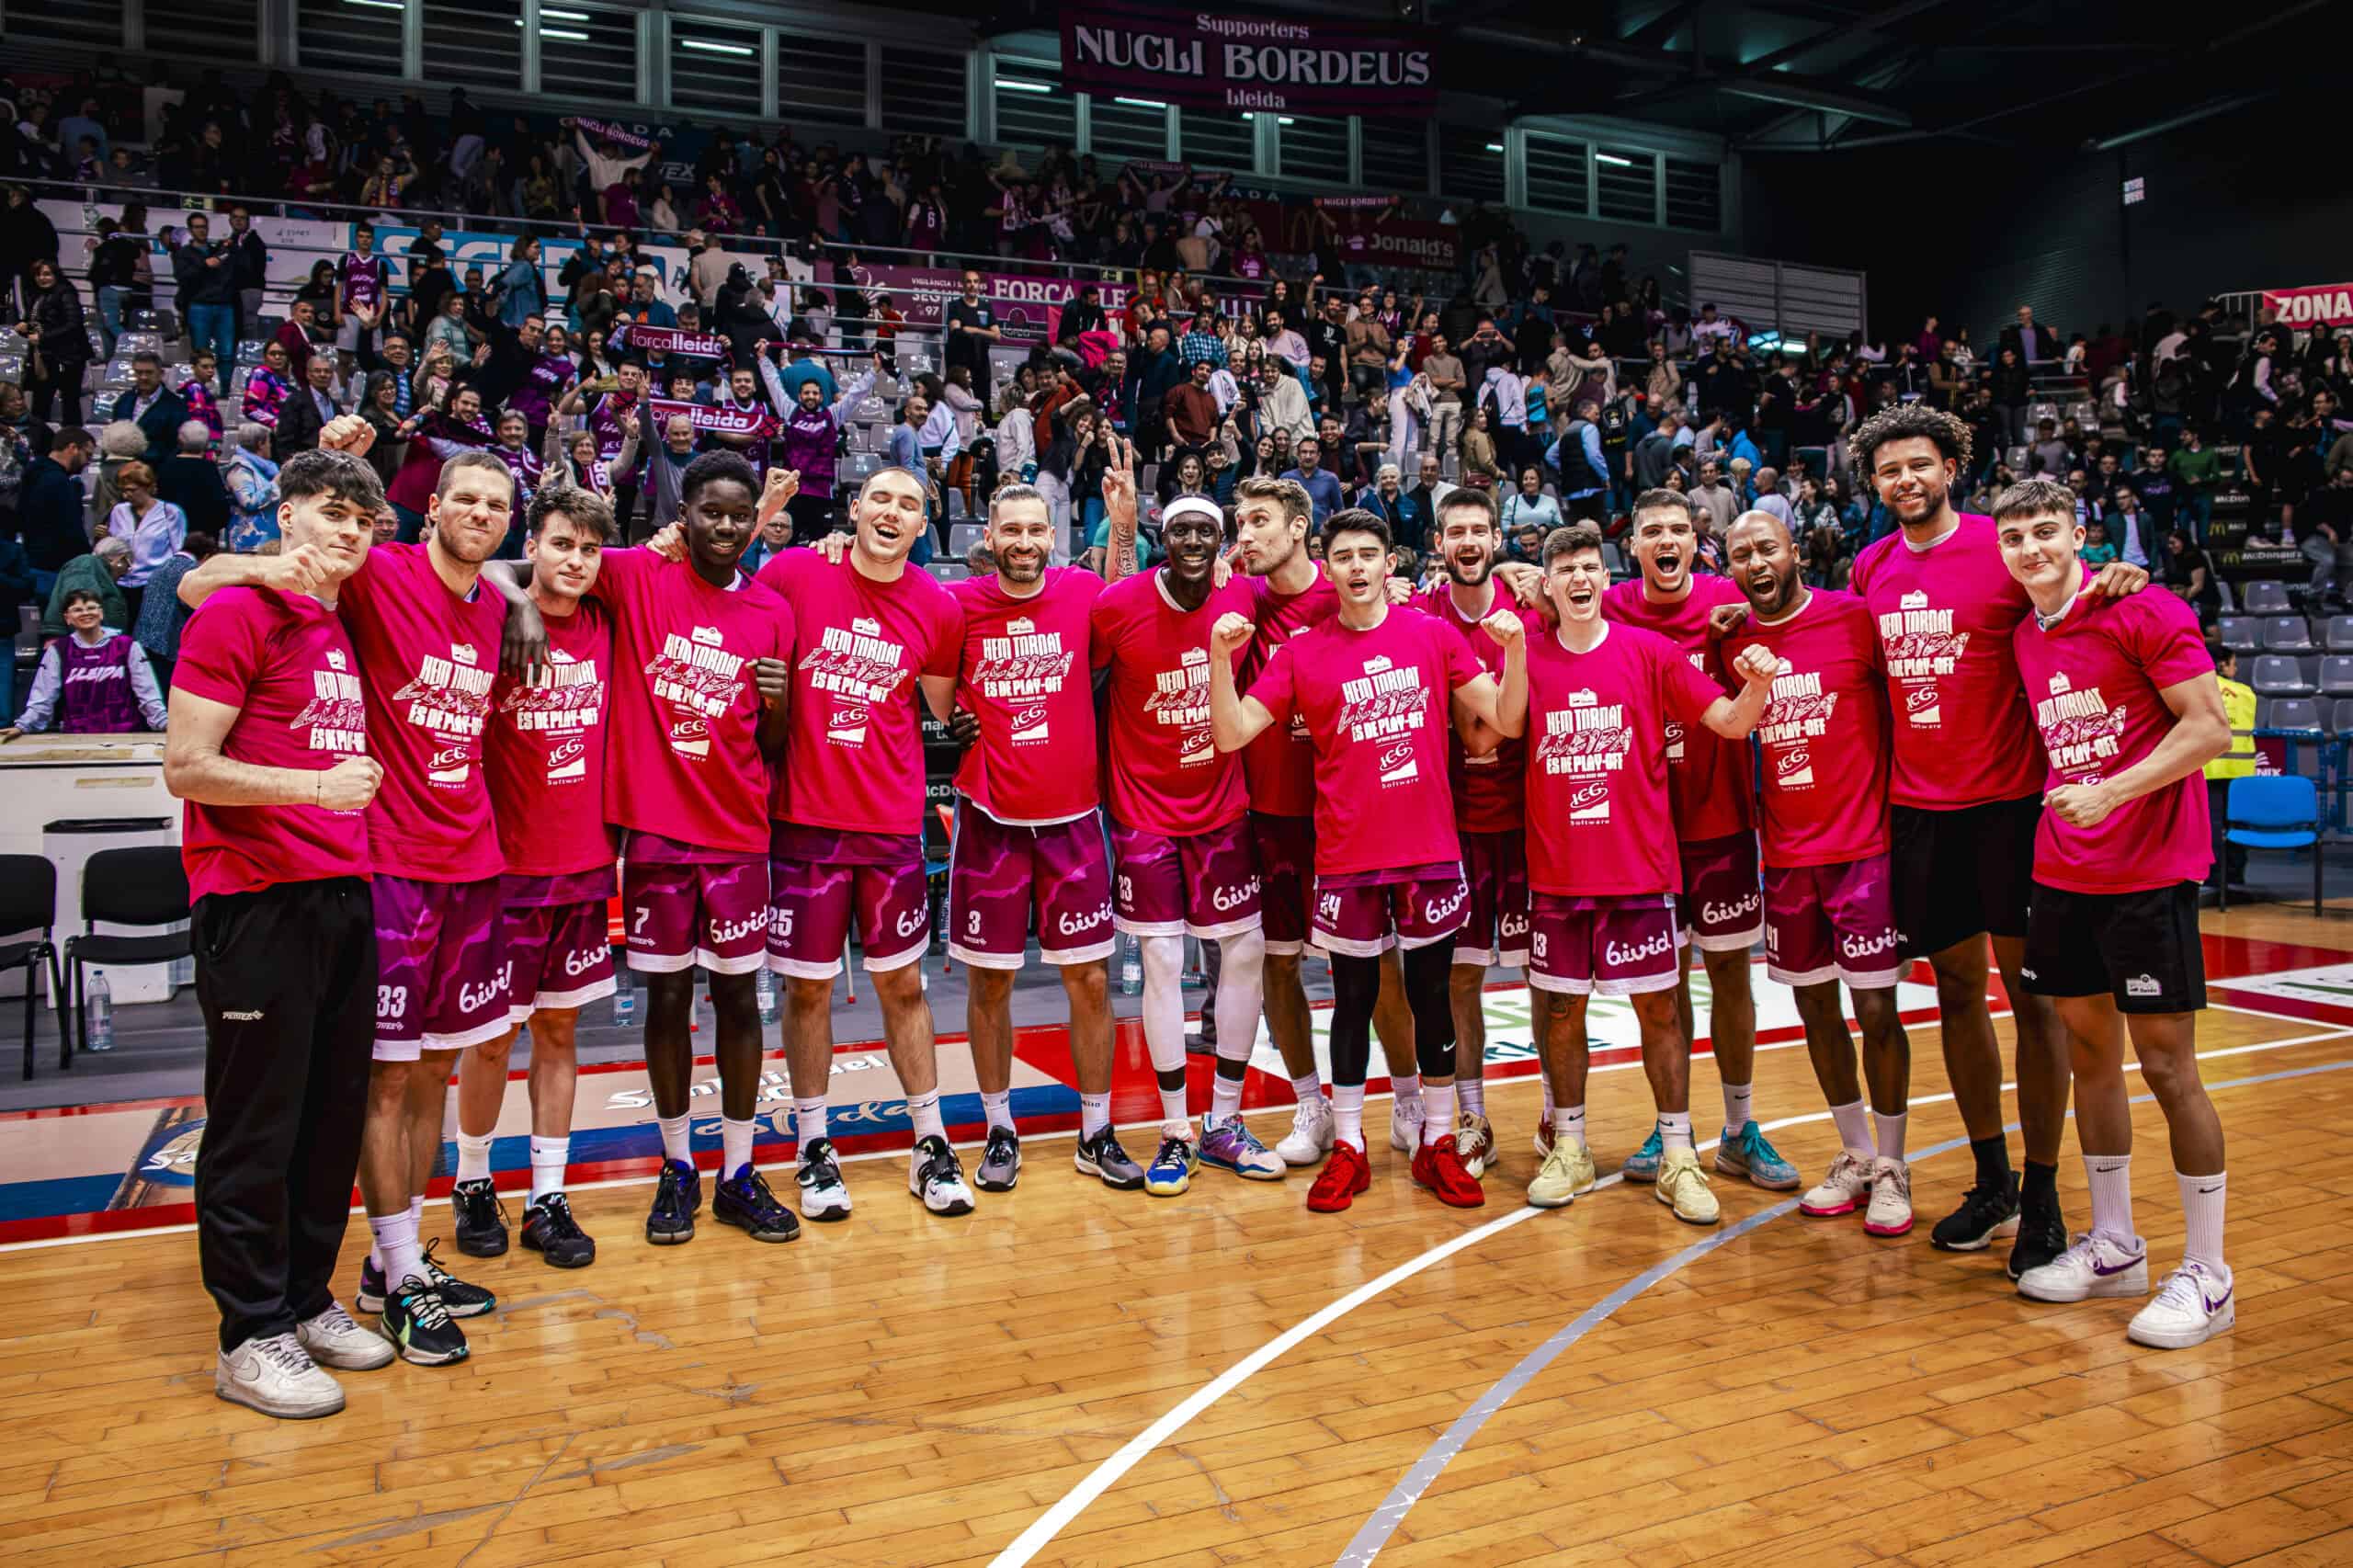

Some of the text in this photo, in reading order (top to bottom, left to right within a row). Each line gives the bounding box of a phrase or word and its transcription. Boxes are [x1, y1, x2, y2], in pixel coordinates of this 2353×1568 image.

[1196, 14, 1311, 39] Supporters
[1074, 25, 1431, 86] NUCLI BORDEUS
[1226, 88, 1287, 109] Lleida
[2274, 290, 2353, 324] ZONA
[651, 407, 749, 429] orlleida
[1904, 608, 1955, 635] TORNAT
[664, 632, 745, 681] HEM TORNAT
[822, 627, 904, 668] HEM TORNAT
[983, 632, 1063, 661] HEM TORNAT
[1883, 631, 1971, 660] LEIDA
[419, 654, 453, 688] HEM
[449, 664, 494, 697] TORNAT
[798, 647, 909, 691] LLEIDA
[972, 651, 1074, 685] LLEIDA
[1156, 663, 1211, 694] HEM TOR
[1904, 656, 1956, 676] PLAY-OFF
[644, 653, 746, 707] LLEIDA
[811, 667, 828, 689] ÉS
[840, 676, 891, 703] PLAY-OFF
[983, 676, 1063, 698] ÉS DE PLAY-OFF
[1342, 665, 1420, 705] HEM TORNAT
[1772, 672, 1823, 701] TORNAT
[1142, 682, 1211, 713] LLEI
[1336, 687, 1430, 735] LLEIDA
[1758, 691, 1838, 726] EIDA
[1905, 686, 1936, 710] ICG
[517, 707, 534, 731] ÉS
[673, 720, 707, 736] ICG
[833, 707, 866, 724] ICG
[1012, 704, 1044, 728] ICG
[1156, 707, 1171, 725] ÉS
[1186, 704, 1211, 723] PLAY
[1351, 722, 1365, 743] ÉS
[1378, 710, 1425, 736] PLAY-OFF
[1546, 704, 1623, 735] HEM TORNAT
[1181, 730, 1213, 753] ICG
[1774, 717, 1826, 741] PLAY-OFF
[432, 746, 467, 767] ICG
[550, 738, 583, 765] ICG
[825, 738, 864, 750] Software
[1012, 739, 1051, 747] Software
[1380, 742, 1411, 769] ICG
[1536, 725, 1633, 764] LLEIDA
[2062, 734, 2120, 767] PLAY-OFF
[1546, 755, 1560, 776] ÉS
[1560, 756, 1574, 774] DE
[1573, 752, 1624, 774] PLAY-OFF
[1777, 748, 1806, 772] ICG
[1381, 777, 1419, 790] Software
[1571, 782, 1605, 807] ICG
[1570, 818, 1610, 826] Software
[634, 906, 650, 935] 7
[968, 910, 981, 935] 3
[1532, 930, 1548, 958] 13
[376, 984, 407, 1018] 33
